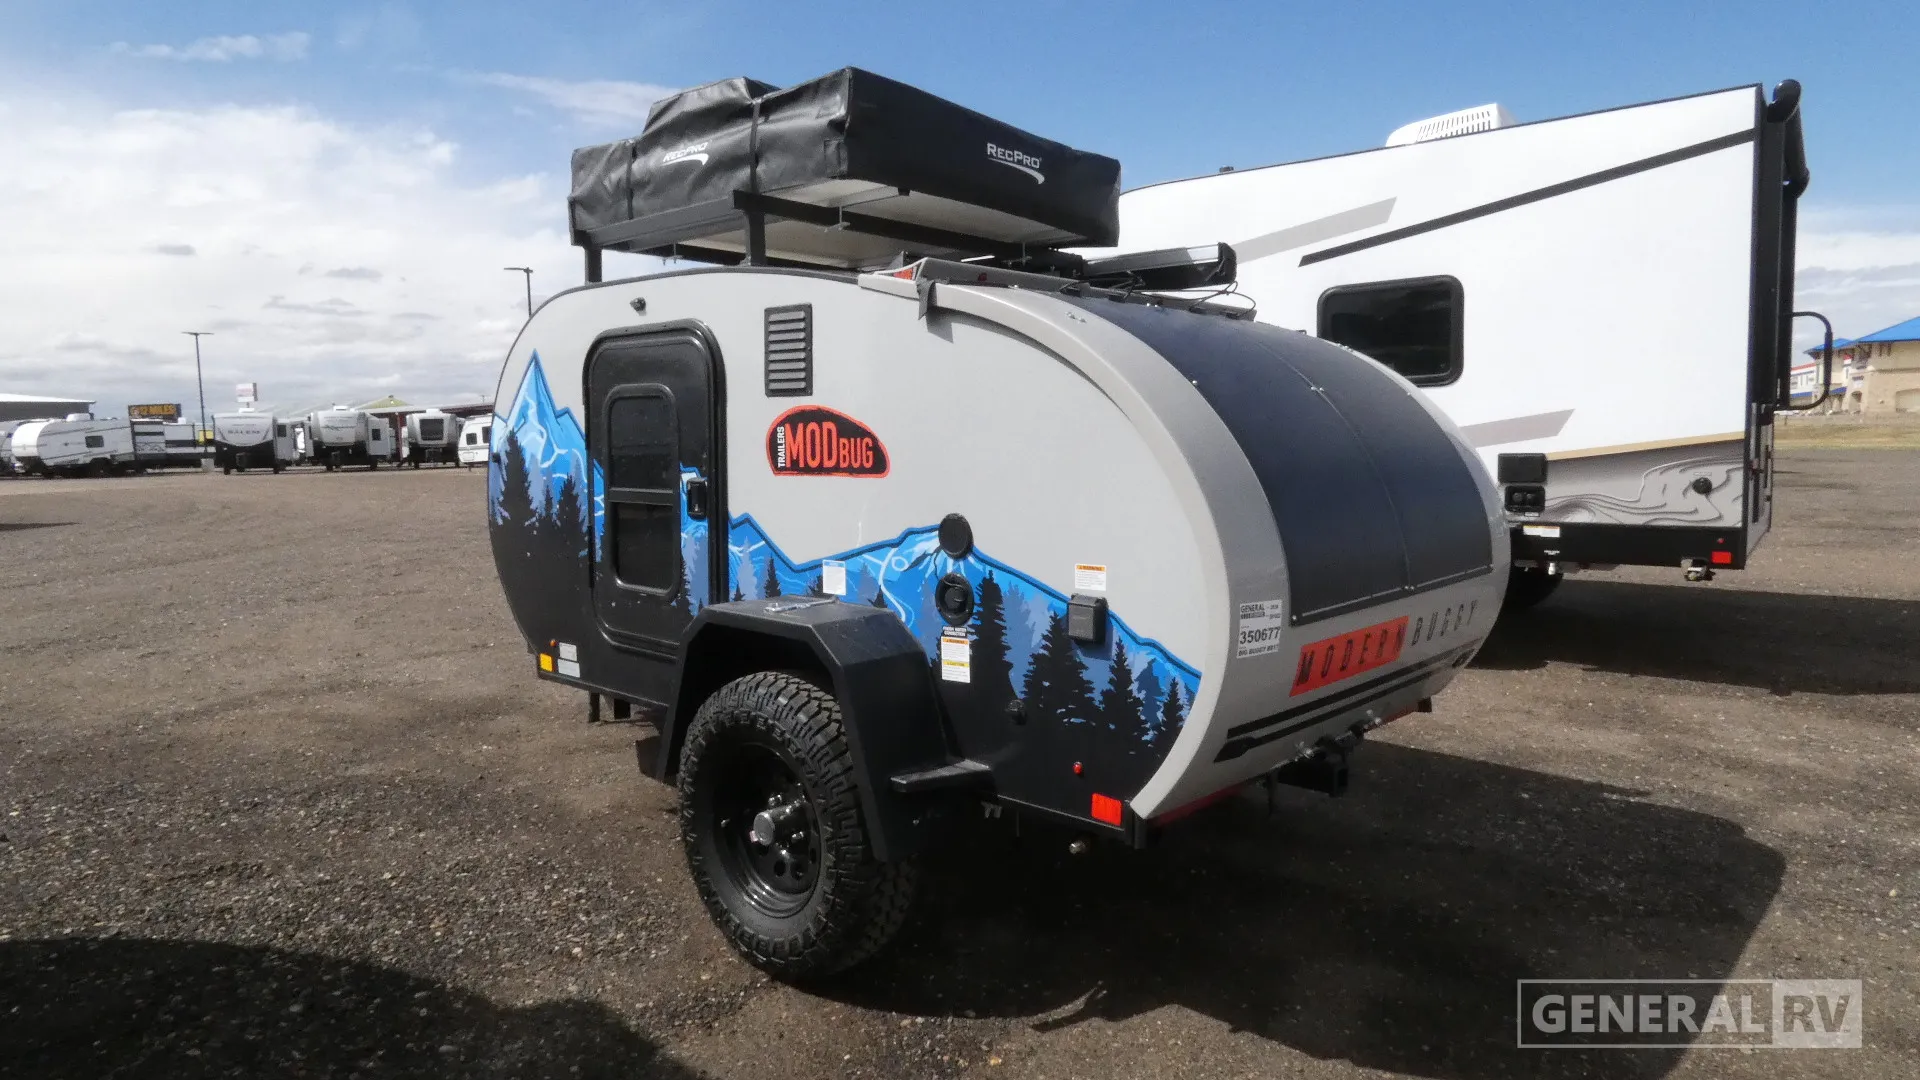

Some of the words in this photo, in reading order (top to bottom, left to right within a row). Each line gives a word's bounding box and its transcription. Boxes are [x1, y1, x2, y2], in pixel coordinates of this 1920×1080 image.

[777, 426, 785, 467] TRAILERS
[1240, 626, 1281, 644] 350677
[1297, 623, 1407, 686] MODERN
[1412, 600, 1478, 646] BUGGY
